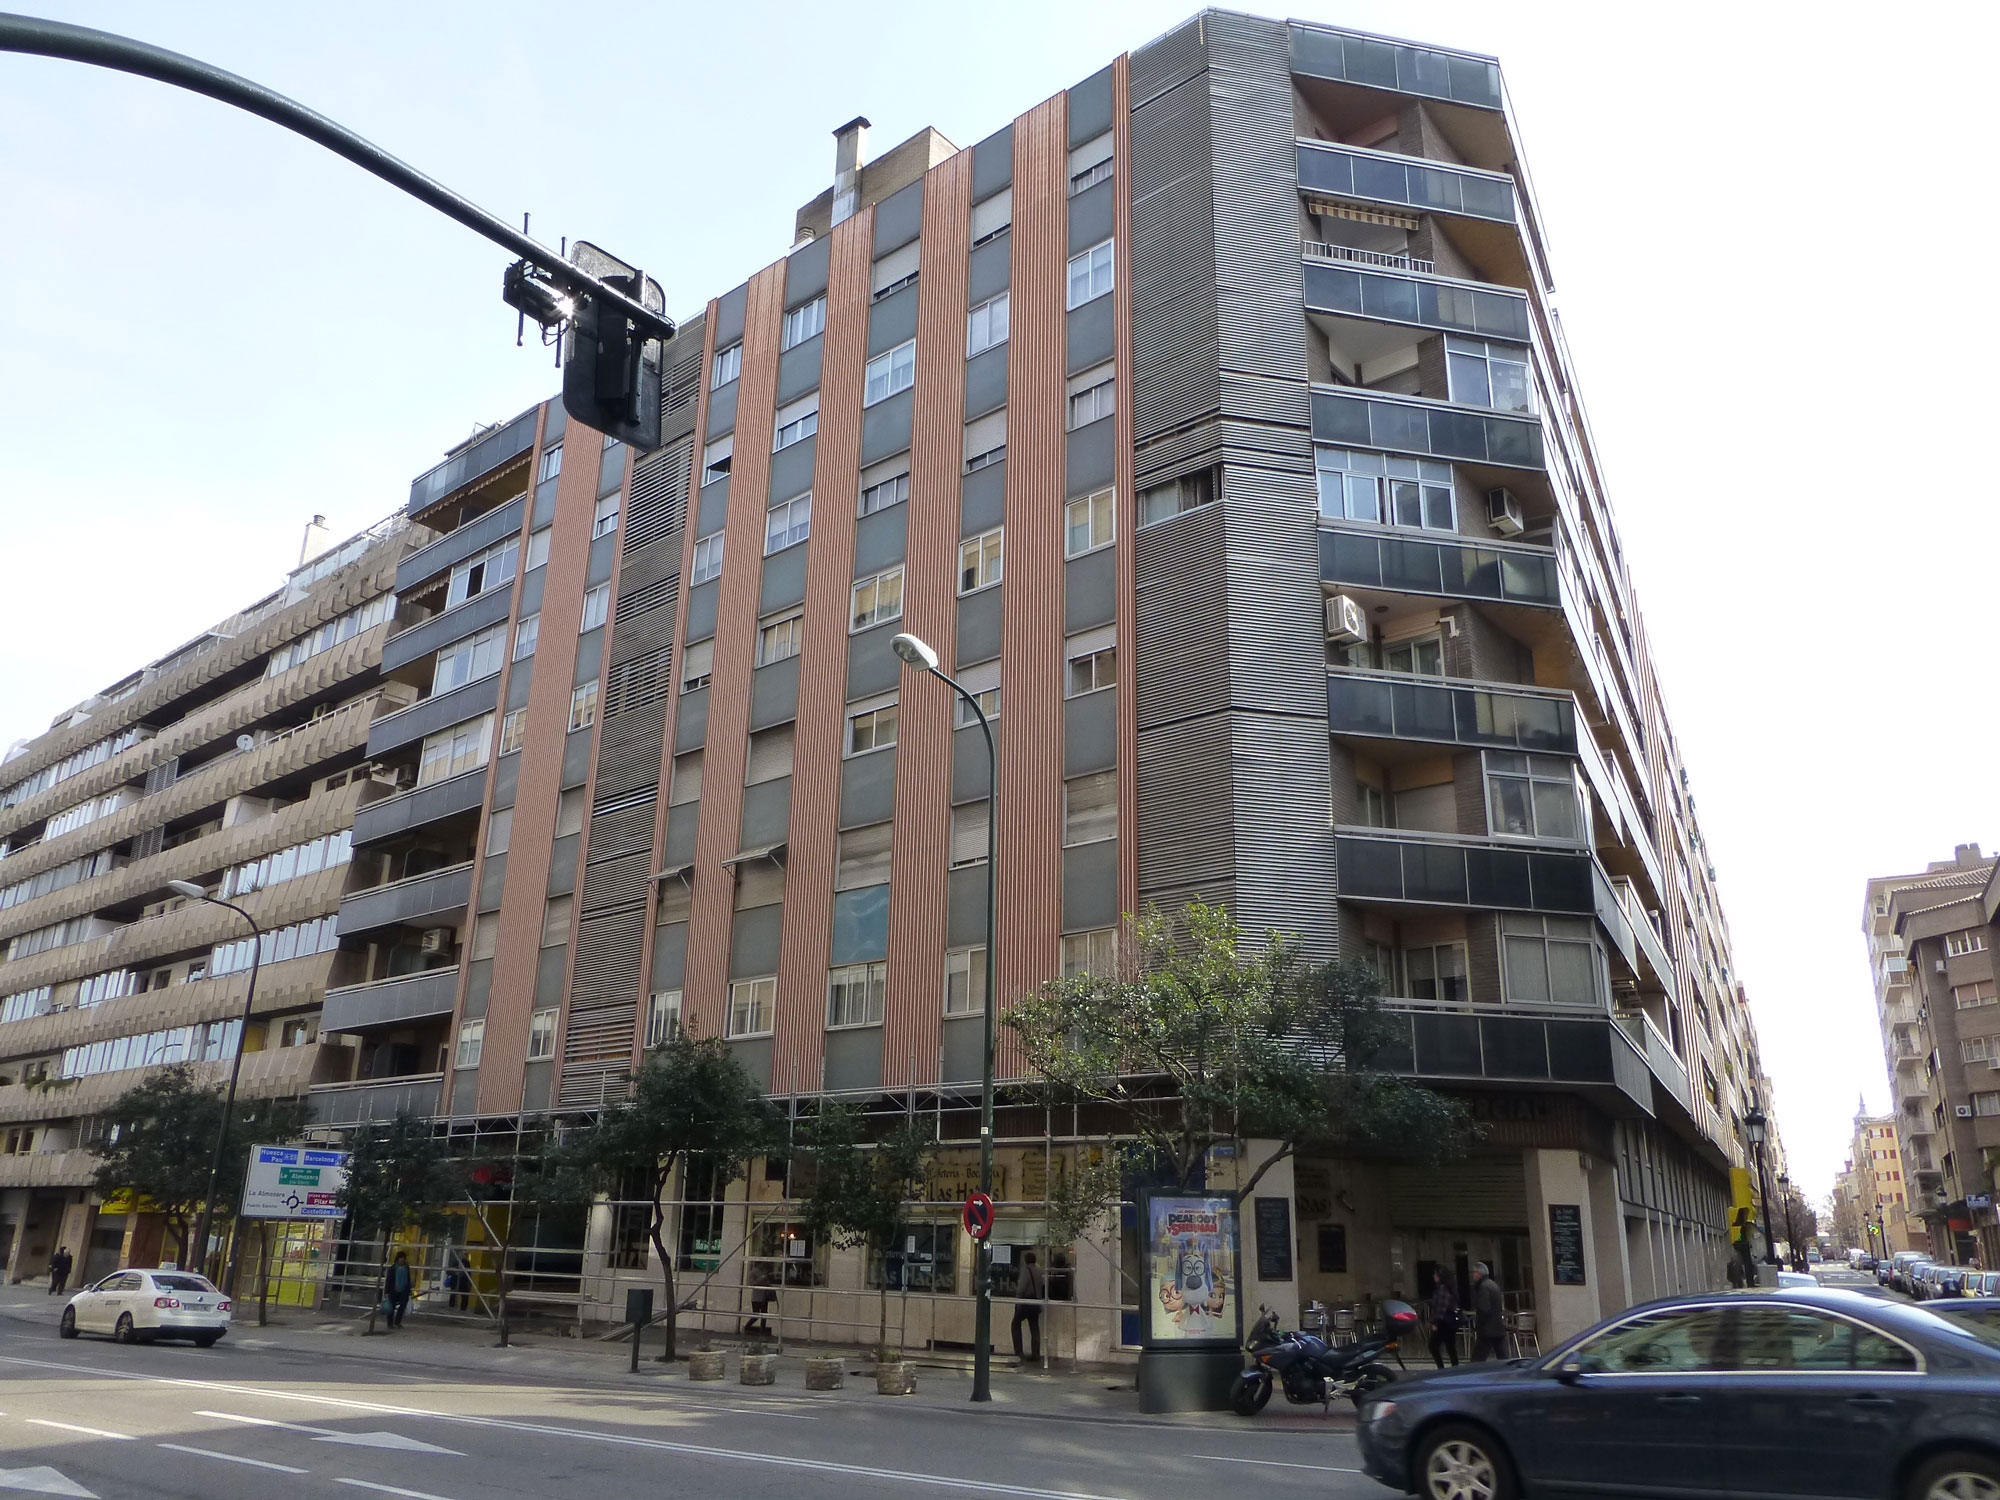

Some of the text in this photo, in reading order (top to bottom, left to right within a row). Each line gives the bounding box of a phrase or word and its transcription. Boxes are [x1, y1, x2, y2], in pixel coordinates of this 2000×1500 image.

[305, 1154, 334, 1163] Barcelona
[1168, 1214, 1217, 1226] PEABODY
[1171, 1224, 1217, 1236] SHERMAN
